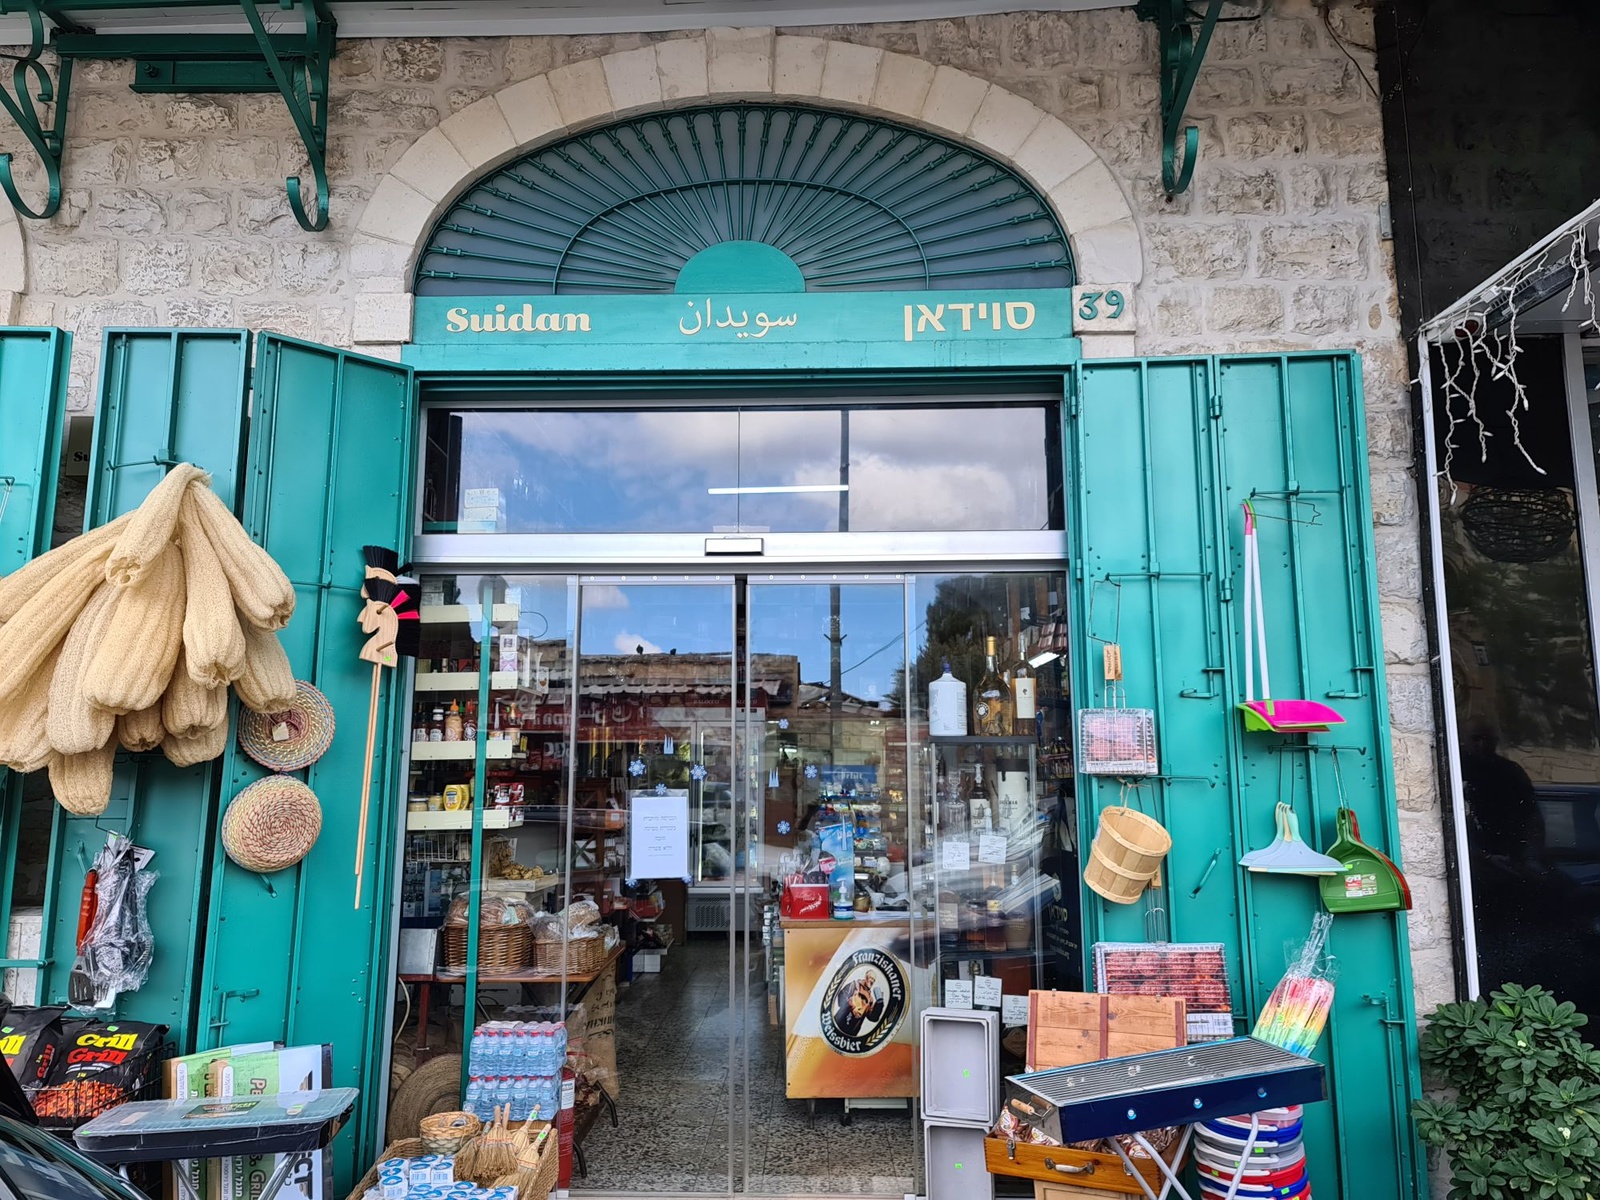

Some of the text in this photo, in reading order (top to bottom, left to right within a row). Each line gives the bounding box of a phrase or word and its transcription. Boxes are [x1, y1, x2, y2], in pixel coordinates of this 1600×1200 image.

[446, 304, 591, 333] Suidan
[679, 298, 798, 338] سويدان
[903, 301, 1036, 342] סוידאן
[1078, 289, 1125, 321] 39
[852, 951, 902, 1001] Franziskaner
[76, 1033, 139, 1051] Grill
[821, 1010, 862, 1052] Weissbier
[66, 1047, 129, 1065] Grill
